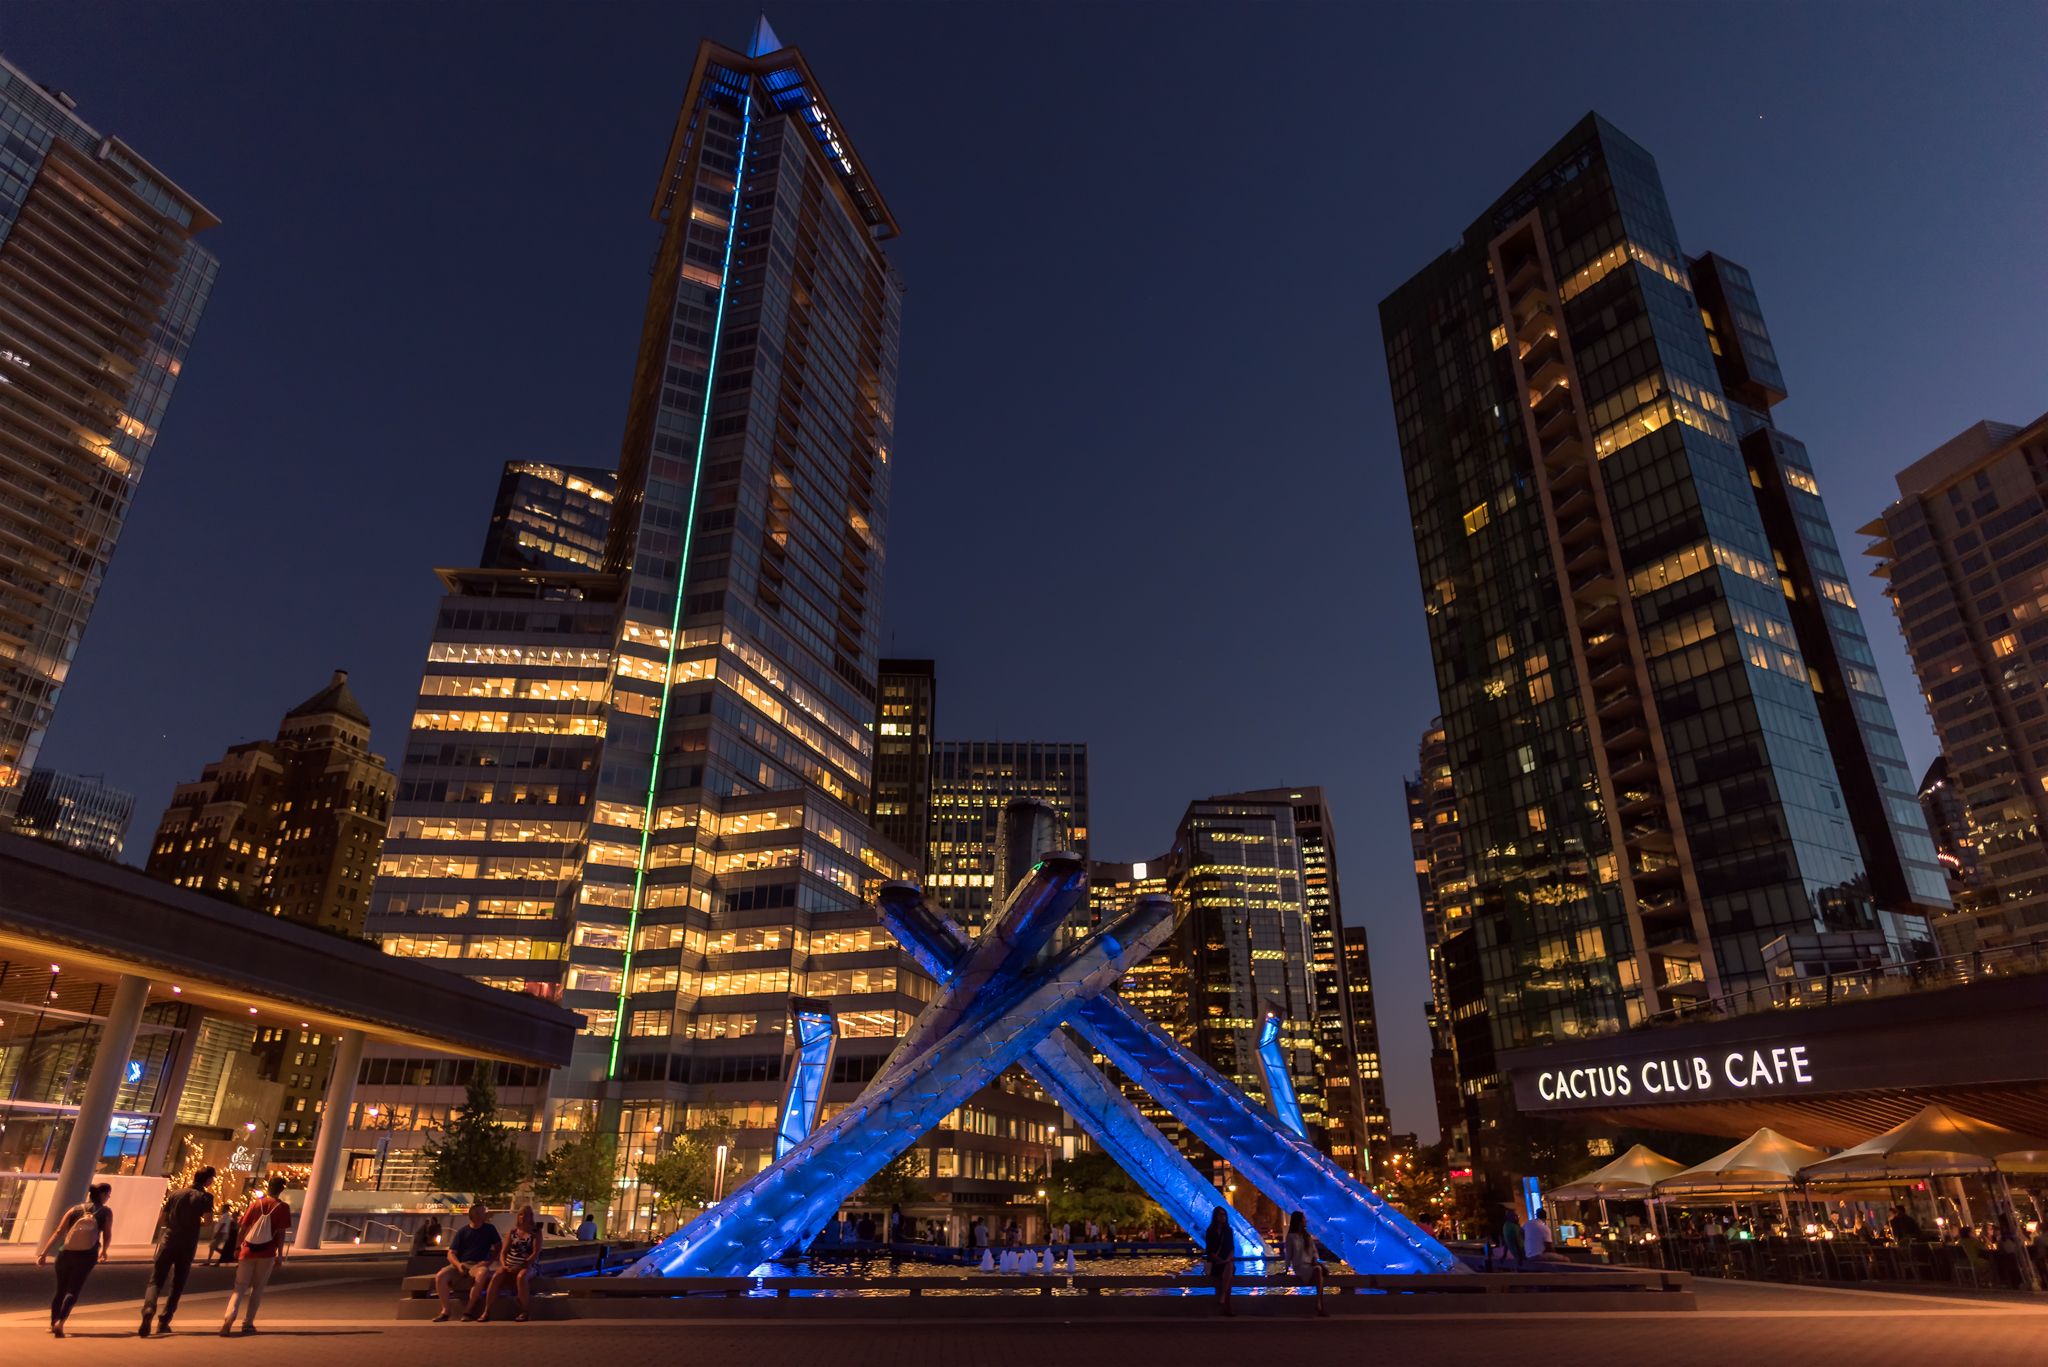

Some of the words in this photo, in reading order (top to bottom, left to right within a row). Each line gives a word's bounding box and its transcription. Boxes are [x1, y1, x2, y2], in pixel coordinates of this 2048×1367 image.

[1538, 1064, 1632, 1101] CACTUS
[1641, 1057, 1712, 1094] CLUB
[1724, 1046, 1812, 1087] CAFE
